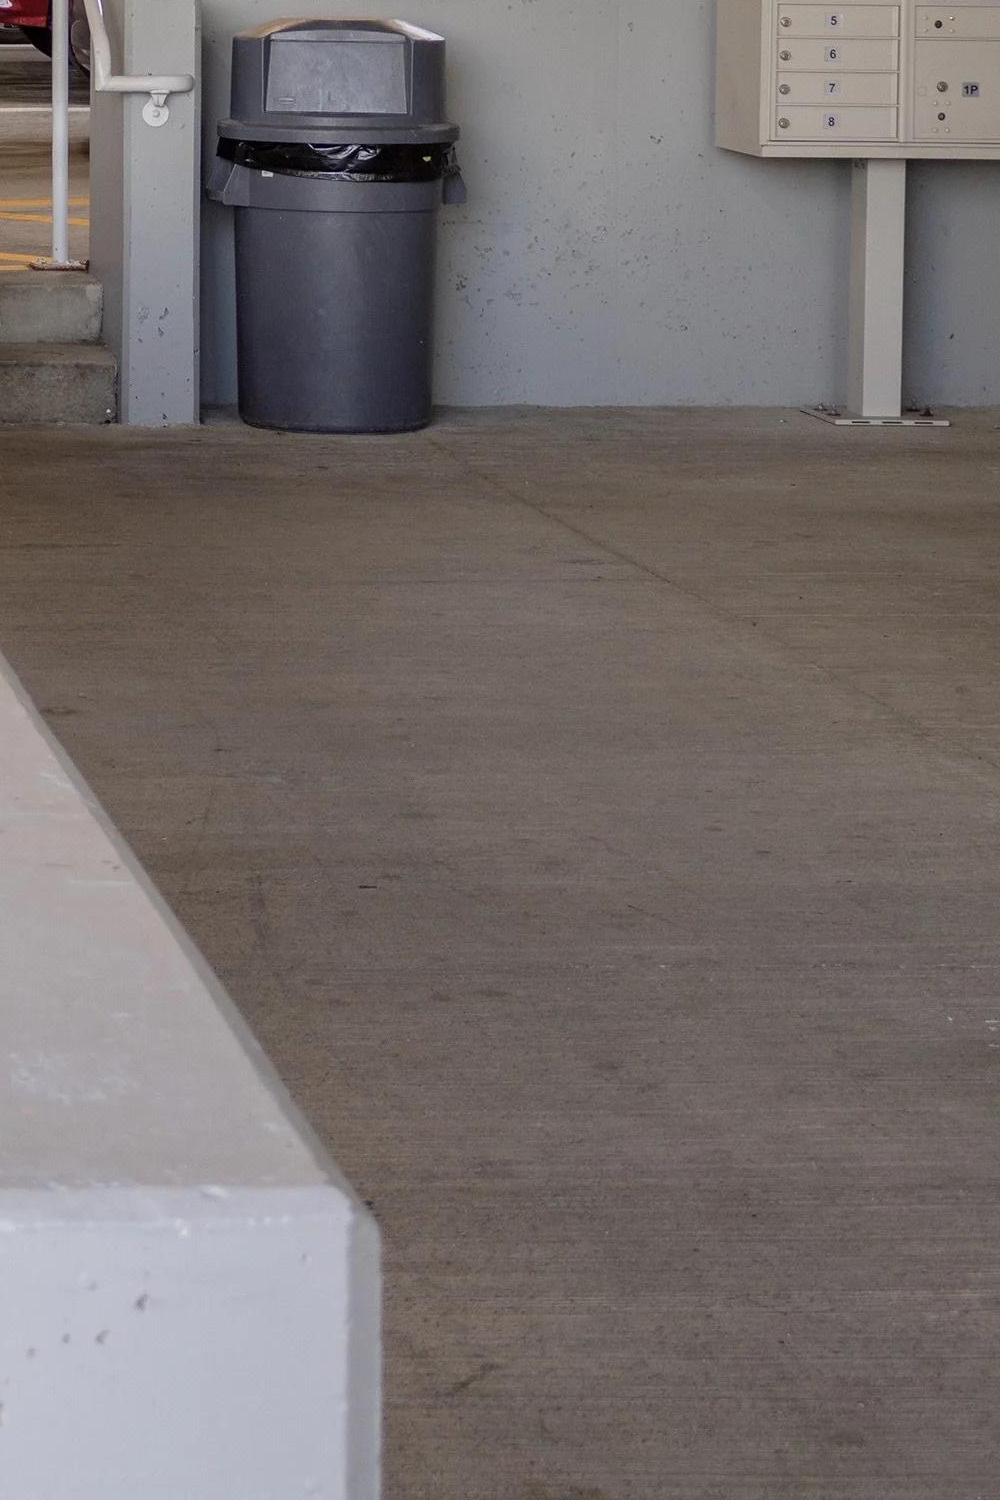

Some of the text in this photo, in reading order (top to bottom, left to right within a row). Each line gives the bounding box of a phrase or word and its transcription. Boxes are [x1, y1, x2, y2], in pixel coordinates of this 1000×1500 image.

[830, 16, 837, 25] 5
[829, 49, 837, 58] 6
[829, 83, 836, 93] 7
[964, 85, 979, 95] 1P
[828, 116, 835, 126] 8
